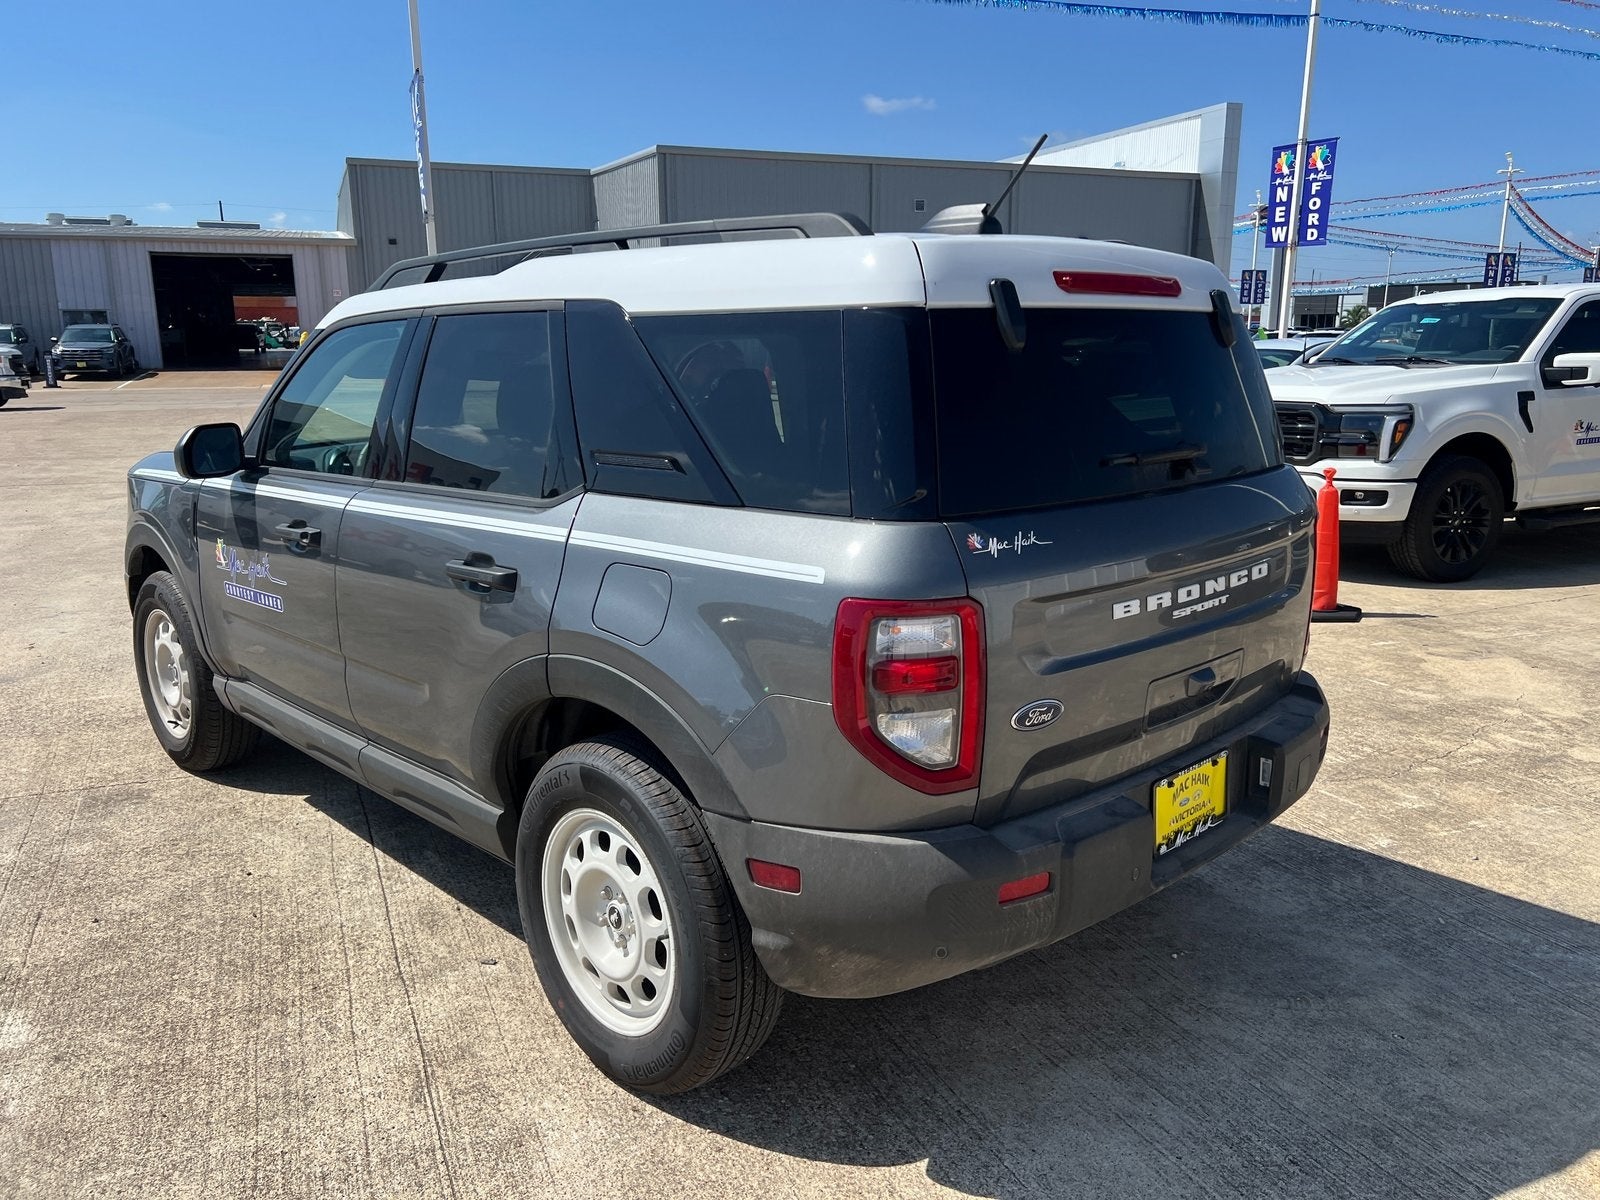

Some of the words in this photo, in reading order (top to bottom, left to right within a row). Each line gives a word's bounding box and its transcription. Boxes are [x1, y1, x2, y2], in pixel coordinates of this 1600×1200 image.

[1271, 186, 1289, 242] NEW
[1306, 182, 1322, 241] FORD
[973, 536, 1013, 558] Mac
[1014, 530, 1053, 554] Haik
[1112, 561, 1270, 620] BRONCO
[1172, 594, 1229, 619] SPORT
[1024, 706, 1055, 728] Ford
[521, 773, 563, 833] Continental
[1172, 777, 1190, 806] MAC
[1191, 772, 1210, 788] HAIK
[632, 1028, 687, 1081] Continental
